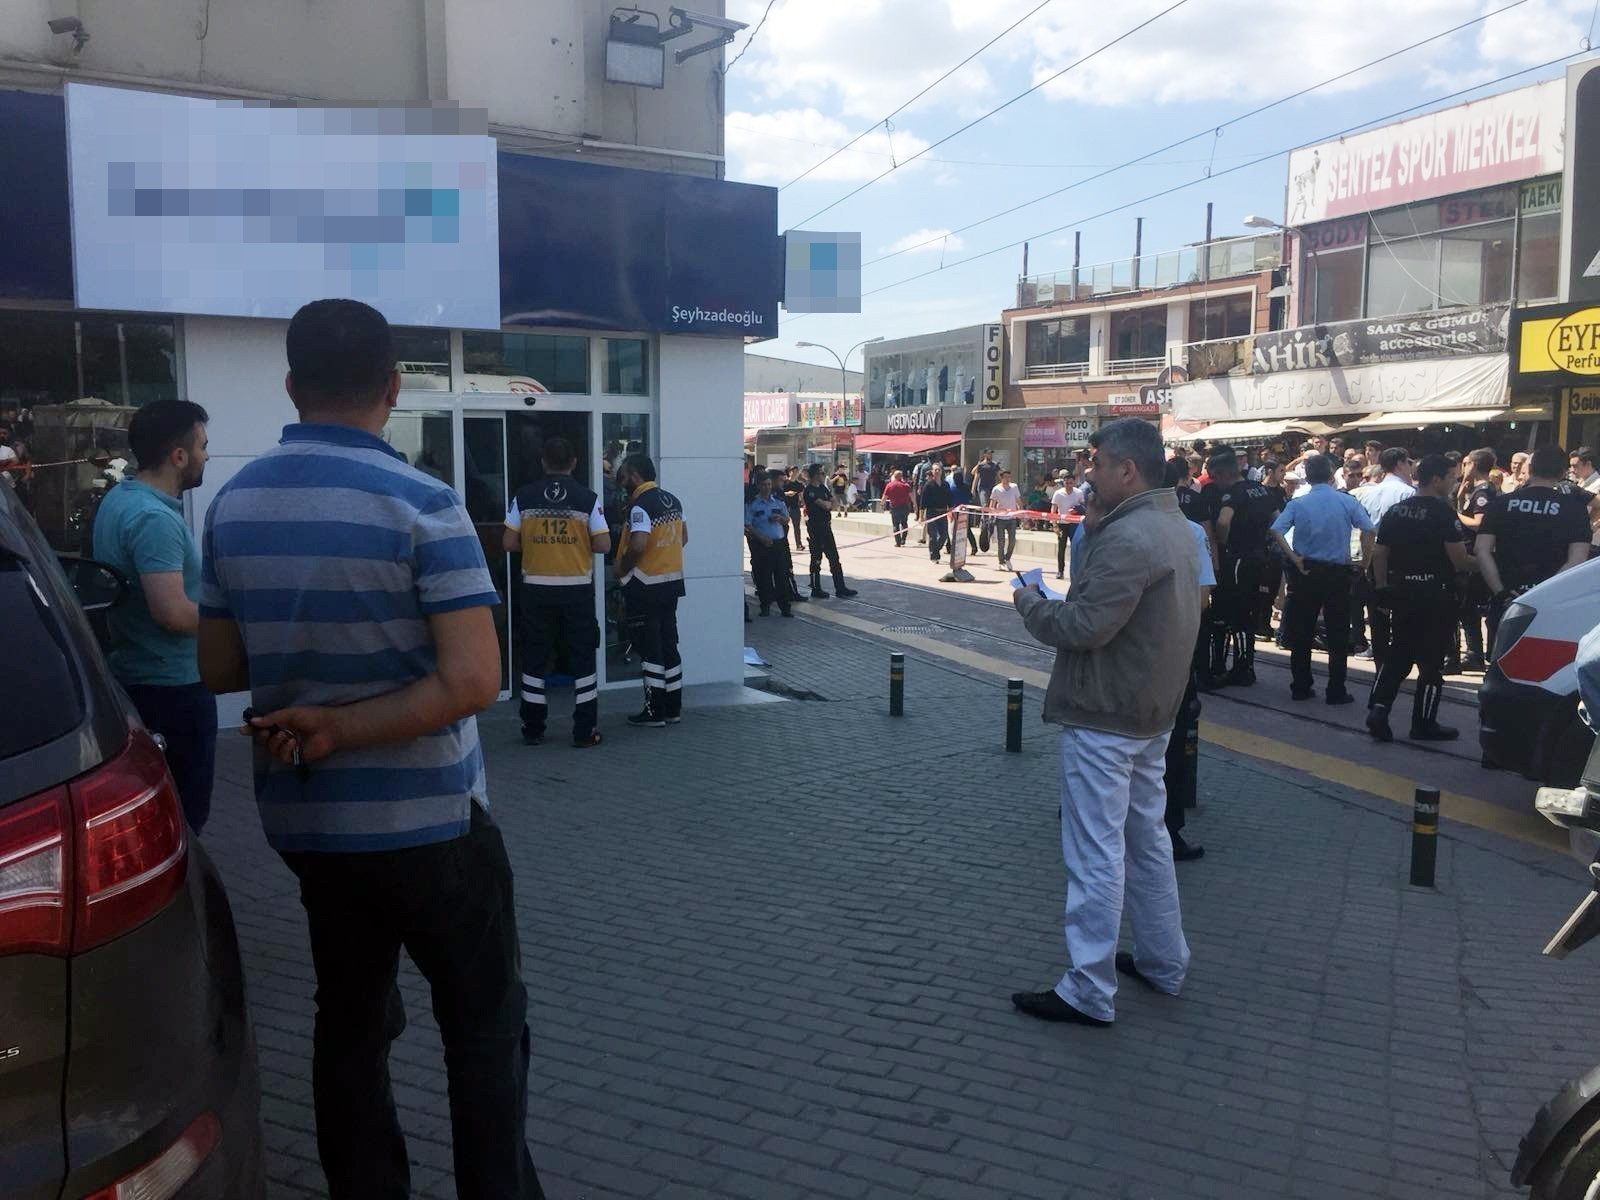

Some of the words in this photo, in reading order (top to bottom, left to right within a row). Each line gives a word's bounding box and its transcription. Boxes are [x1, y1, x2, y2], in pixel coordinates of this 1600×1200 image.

[1328, 144, 1395, 202] SENTEZ
[1397, 127, 1447, 186] SPOR
[1309, 219, 1365, 248] BODY
[672, 305, 763, 327] Şeyhzadeoğlu
[1366, 323, 1405, 336] SAAT
[1408, 321, 1423, 332] &
[1379, 330, 1478, 351] accessories
[986, 326, 1001, 401] FOTO
[1240, 380, 1333, 412] METRO
[1066, 420, 1088, 429] FOTO
[1507, 498, 1560, 516] POLİS
[542, 520, 568, 535] 112
